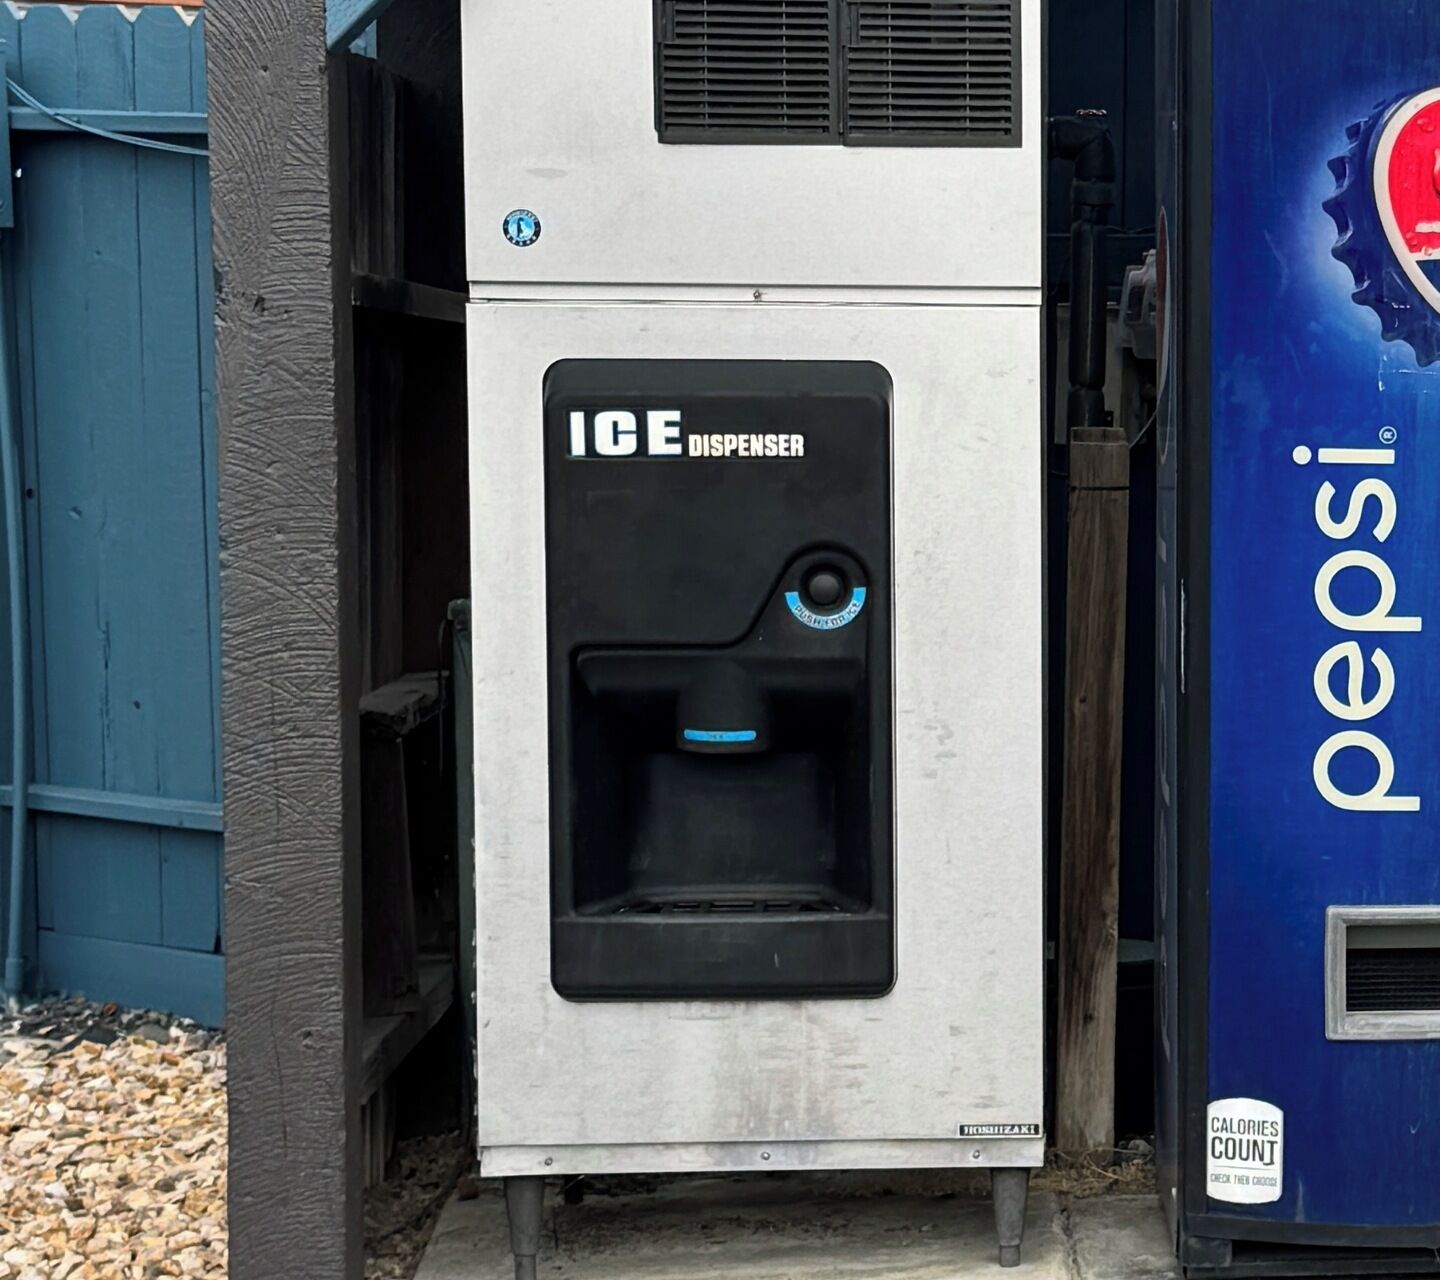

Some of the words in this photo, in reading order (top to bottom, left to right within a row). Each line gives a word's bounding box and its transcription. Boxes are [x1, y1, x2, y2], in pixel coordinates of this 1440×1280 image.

[569, 410, 683, 457] ICE
[688, 433, 805, 457] DISPENSER
[795, 605, 820, 626] PUSH
[1292, 444, 1422, 812] pepsi
[963, 1125, 1035, 1135] HOSHIZAKI
[1211, 1116, 1279, 1137] CALORIES
[1211, 1136, 1279, 1166] COUNT
